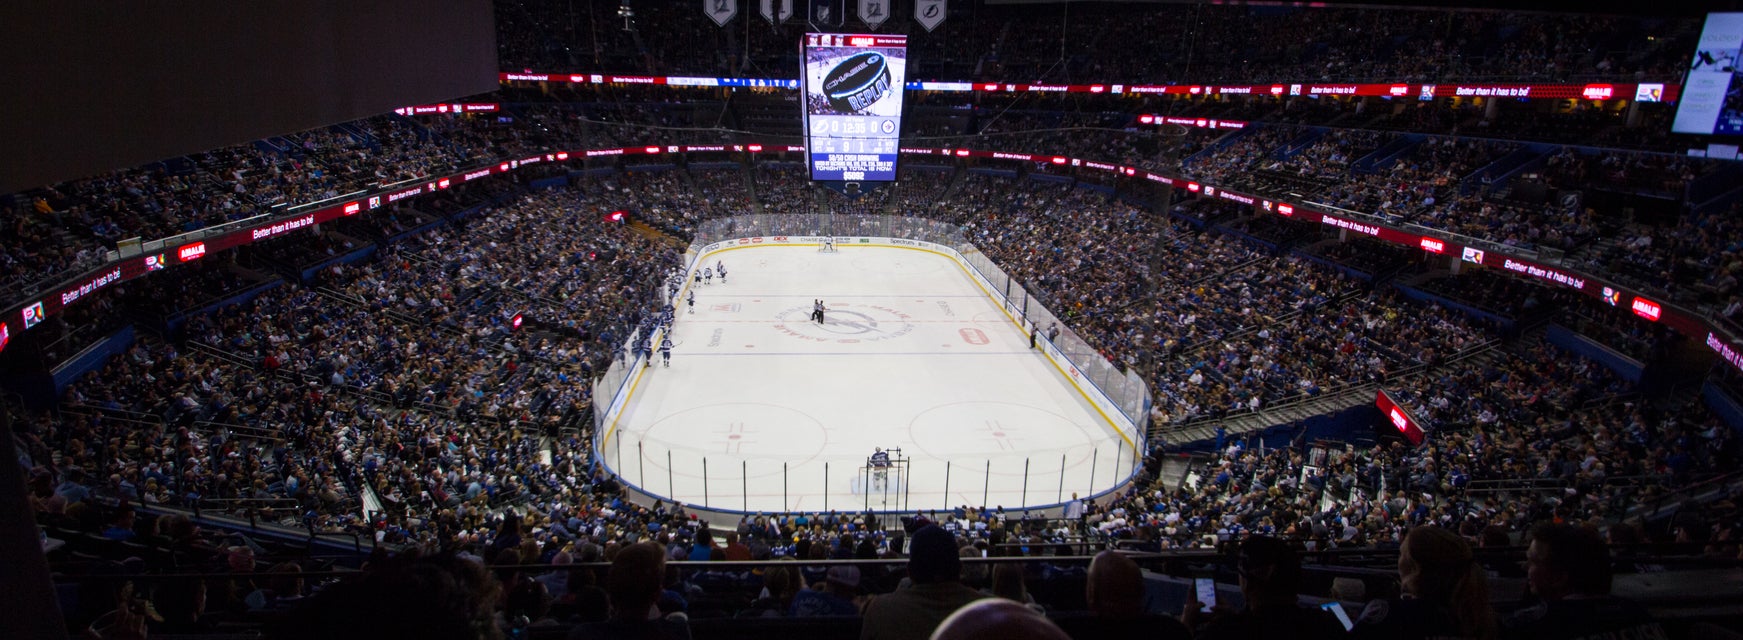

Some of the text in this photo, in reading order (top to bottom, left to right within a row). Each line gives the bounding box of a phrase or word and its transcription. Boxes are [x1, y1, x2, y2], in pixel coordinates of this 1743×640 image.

[826, 62, 868, 90] CHASE
[848, 73, 889, 110] REPLAY
[1496, 87, 1509, 95] has
[1583, 88, 1612, 96] AMALIE
[254, 228, 271, 239] Better
[272, 225, 284, 234] than
[285, 222, 289, 230] it
[1323, 215, 1337, 225] Better
[1338, 220, 1349, 228] than
[1354, 223, 1363, 232] has
[182, 244, 205, 258] AMALIE
[1421, 240, 1442, 250] AMALIE
[1504, 259, 1528, 272] Better
[1528, 266, 1546, 277] than
[1546, 270, 1553, 279] it
[1553, 272, 1567, 283] has
[1567, 276, 1574, 286] to
[62, 290, 79, 304] Better
[80, 283, 92, 296] than
[93, 279, 97, 289] it
[97, 276, 107, 287] has
[108, 273, 113, 282] to
[1633, 300, 1659, 318] AMALIE
[1707, 332, 1723, 352] Better
[1722, 344, 1734, 362] than
